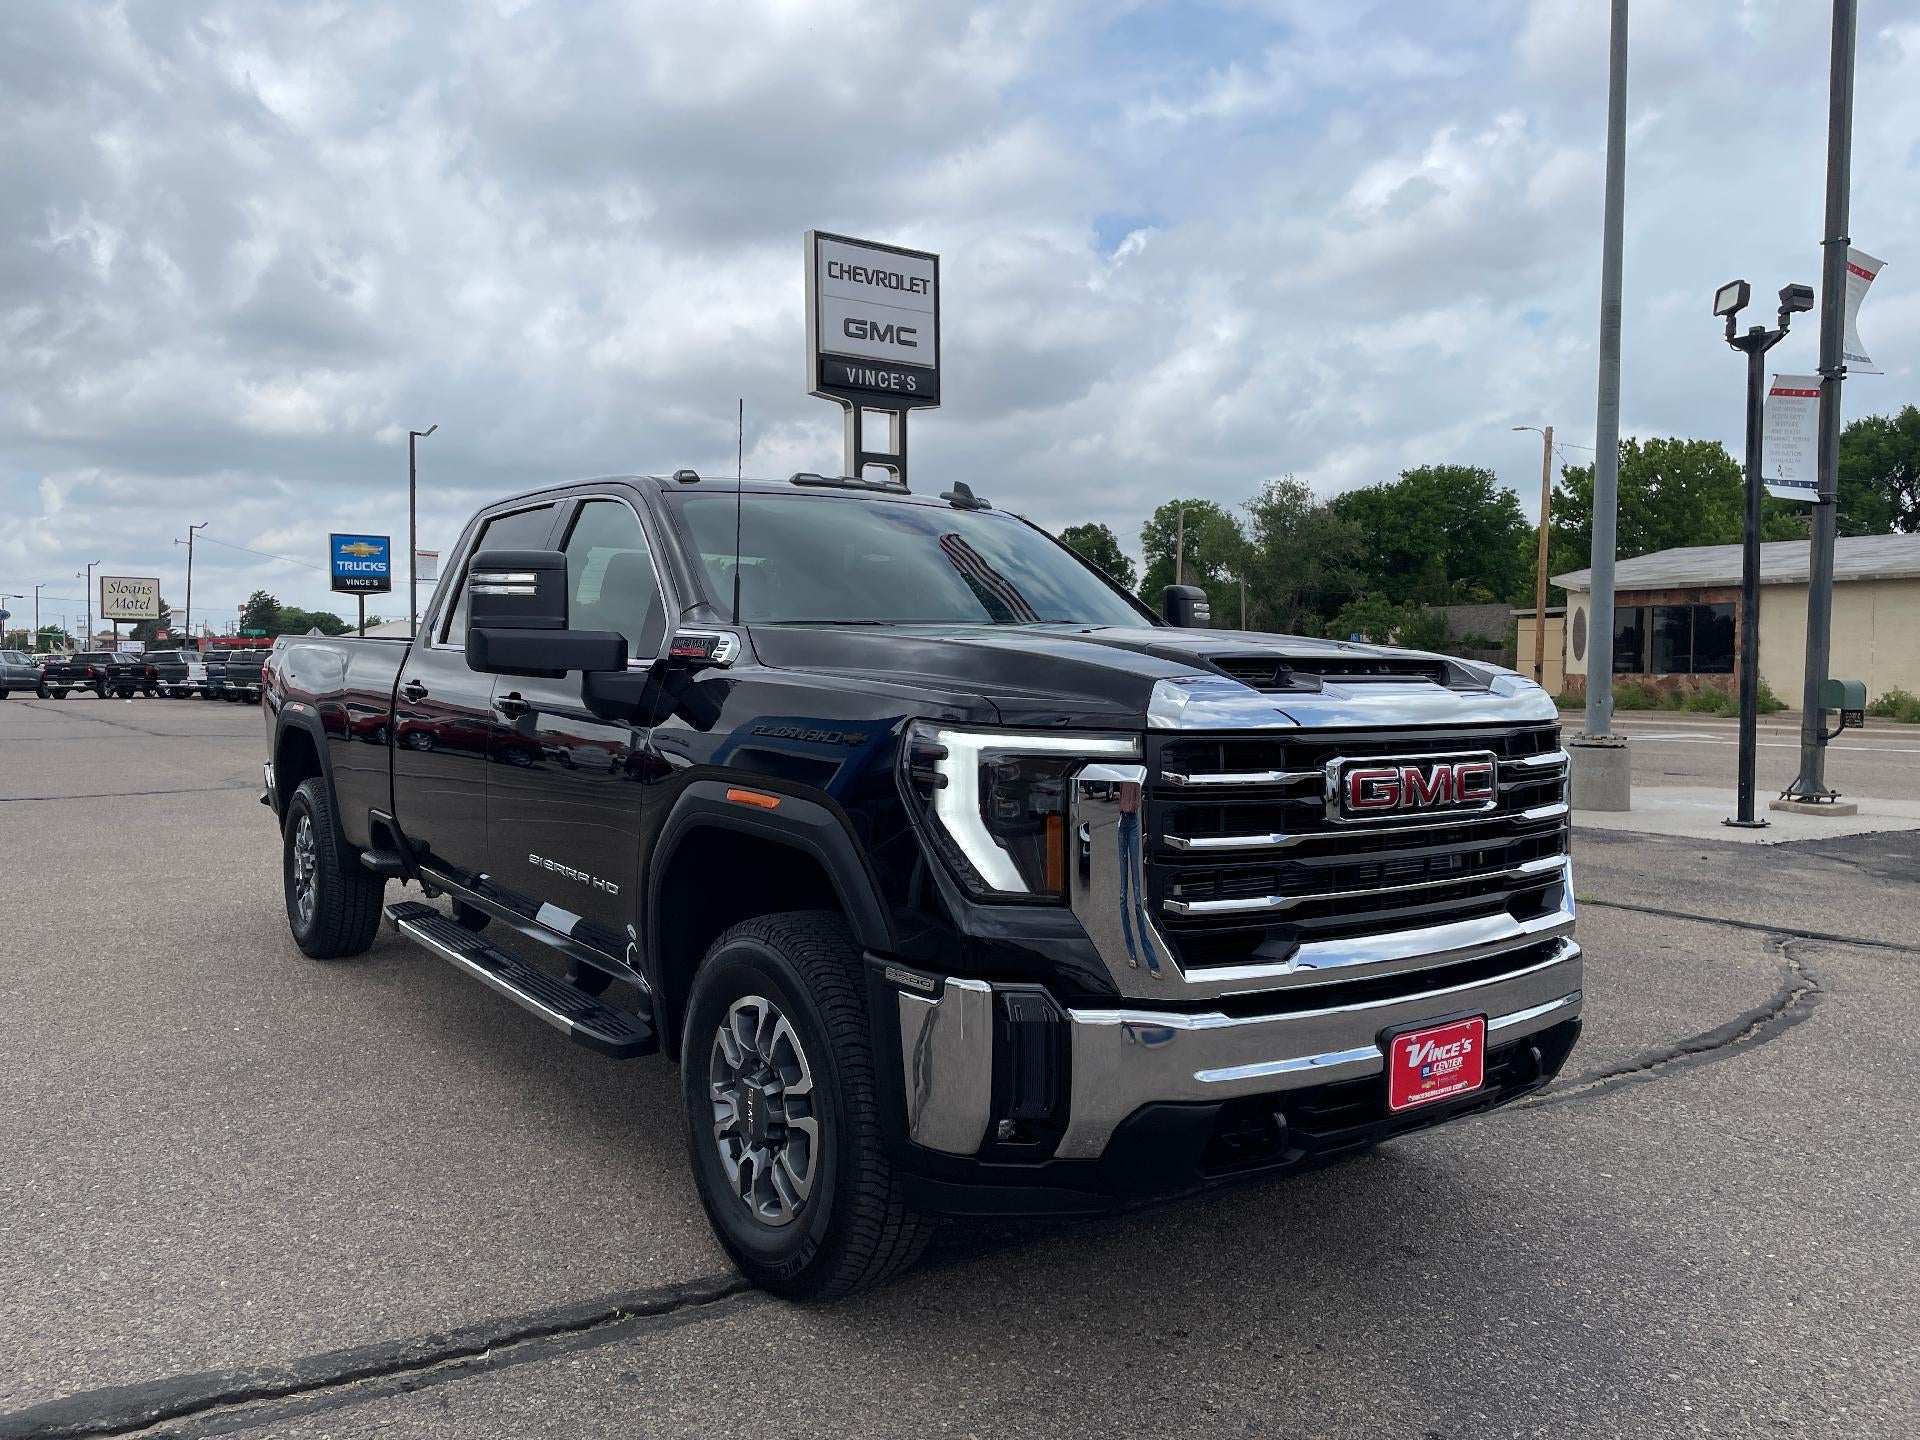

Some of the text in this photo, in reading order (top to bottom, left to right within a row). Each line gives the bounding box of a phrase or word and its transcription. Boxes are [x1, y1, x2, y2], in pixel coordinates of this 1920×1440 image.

[828, 261, 931, 295] CHEVROLET
[843, 317, 918, 348] GMC
[846, 367, 917, 391] VINCE'S
[336, 560, 387, 572] TRUCKS
[108, 580, 153, 595] Sloans
[345, 578, 379, 586] VINCE'S
[110, 597, 151, 610] Motel
[1345, 763, 1493, 811] GMC
[528, 853, 619, 896] SIERRA HD
[1433, 1056, 1464, 1072] CENTER
